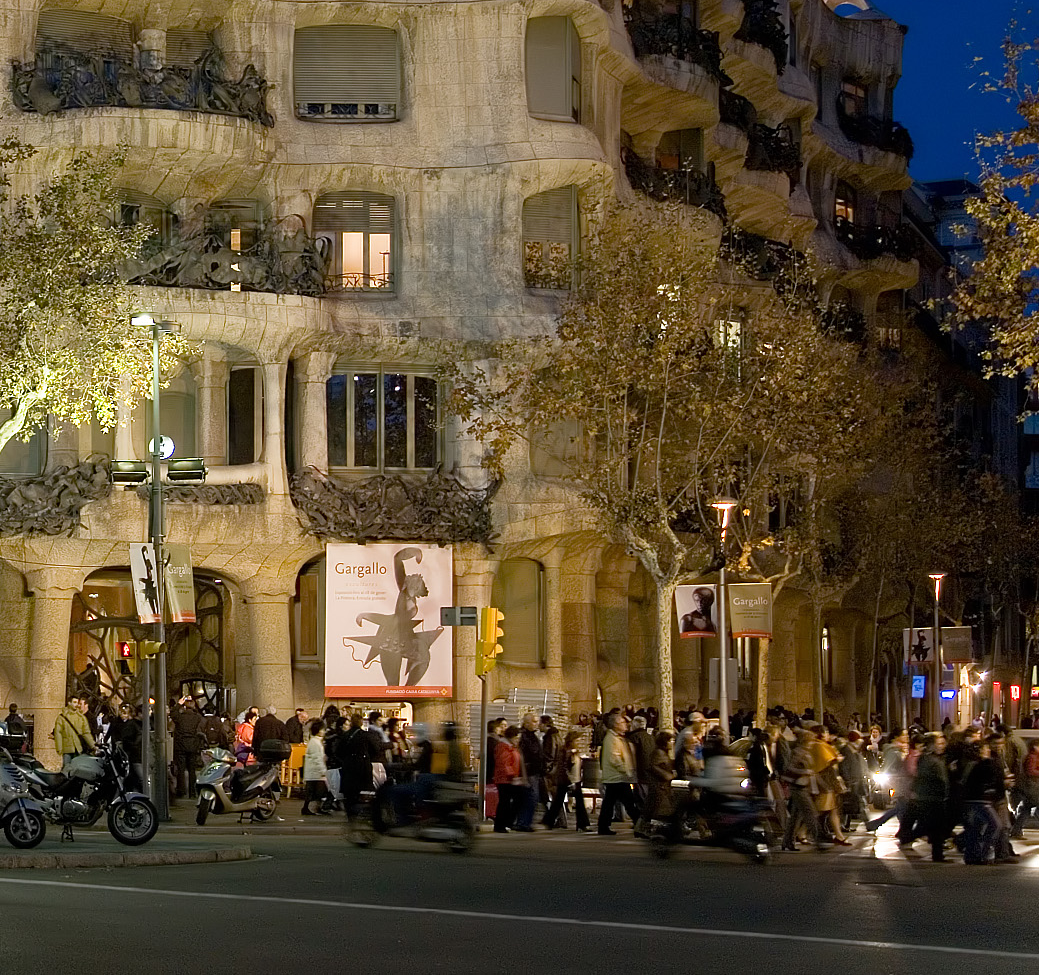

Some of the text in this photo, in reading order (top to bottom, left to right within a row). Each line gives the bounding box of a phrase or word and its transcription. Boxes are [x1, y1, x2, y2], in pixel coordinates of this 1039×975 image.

[167, 564, 191, 578] Gargallo
[335, 562, 387, 578] Gargallo
[732, 597, 768, 607] Gargallo
